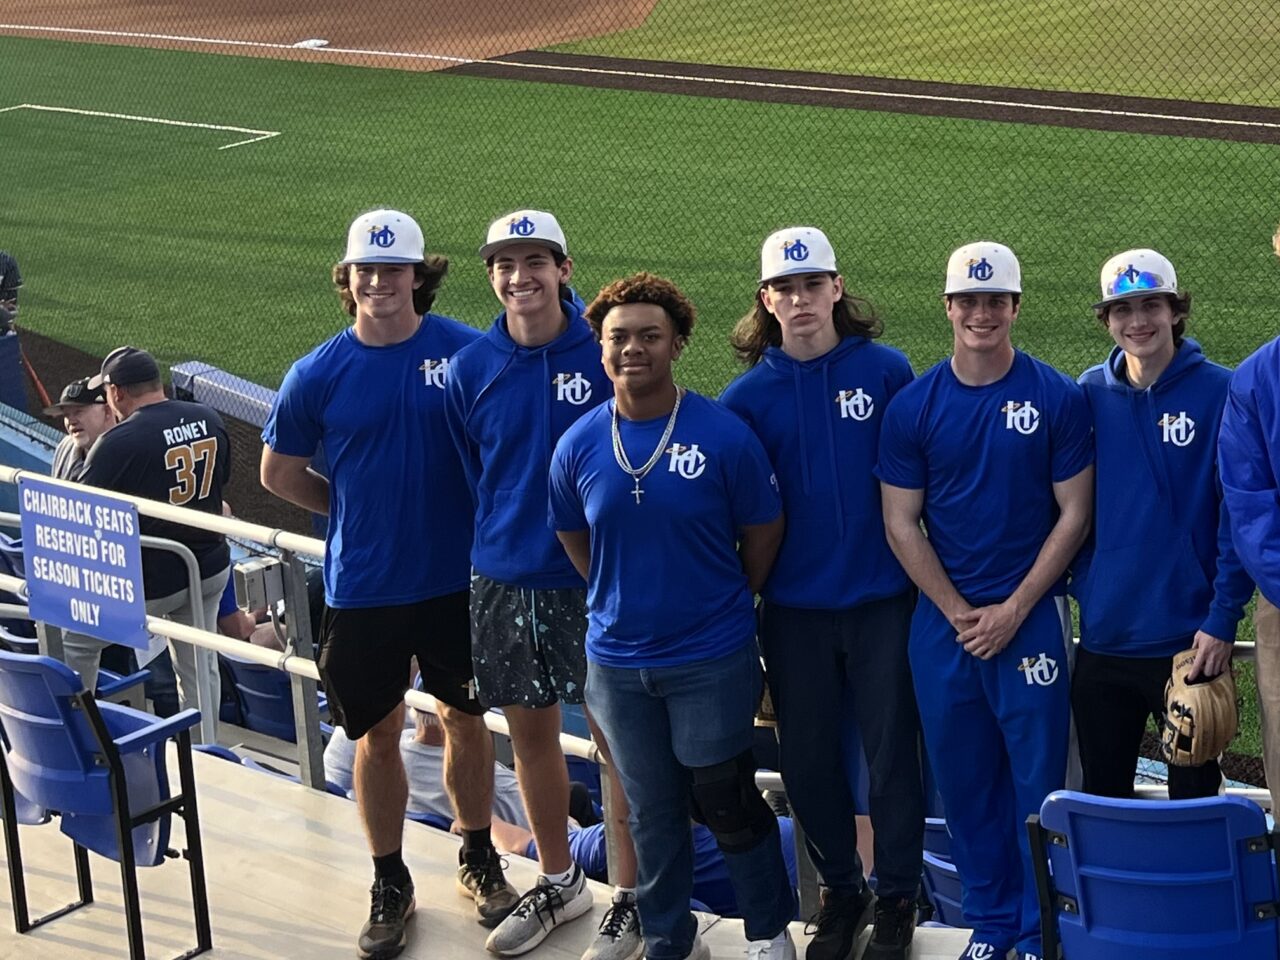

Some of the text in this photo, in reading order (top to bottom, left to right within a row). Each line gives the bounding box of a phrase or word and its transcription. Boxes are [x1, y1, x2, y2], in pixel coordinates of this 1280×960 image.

[369, 225, 396, 248] HC
[509, 216, 536, 236] HC
[783, 238, 809, 262] HC
[967, 257, 994, 281] HC
[555, 371, 592, 406] HC
[838, 387, 874, 421] HC
[163, 420, 208, 446] RONEY
[1005, 400, 1040, 435] HC
[1161, 411, 1196, 446] HC
[164, 437, 218, 506] 37
[666, 443, 706, 479] HC
[23, 488, 134, 537] CHAIRBACK SEATS
[35, 525, 125, 568] RESERVED FOR
[33, 555, 135, 604] SEASON TICKETS
[70, 598, 101, 627] ONLY
[1022, 653, 1059, 686] HC
